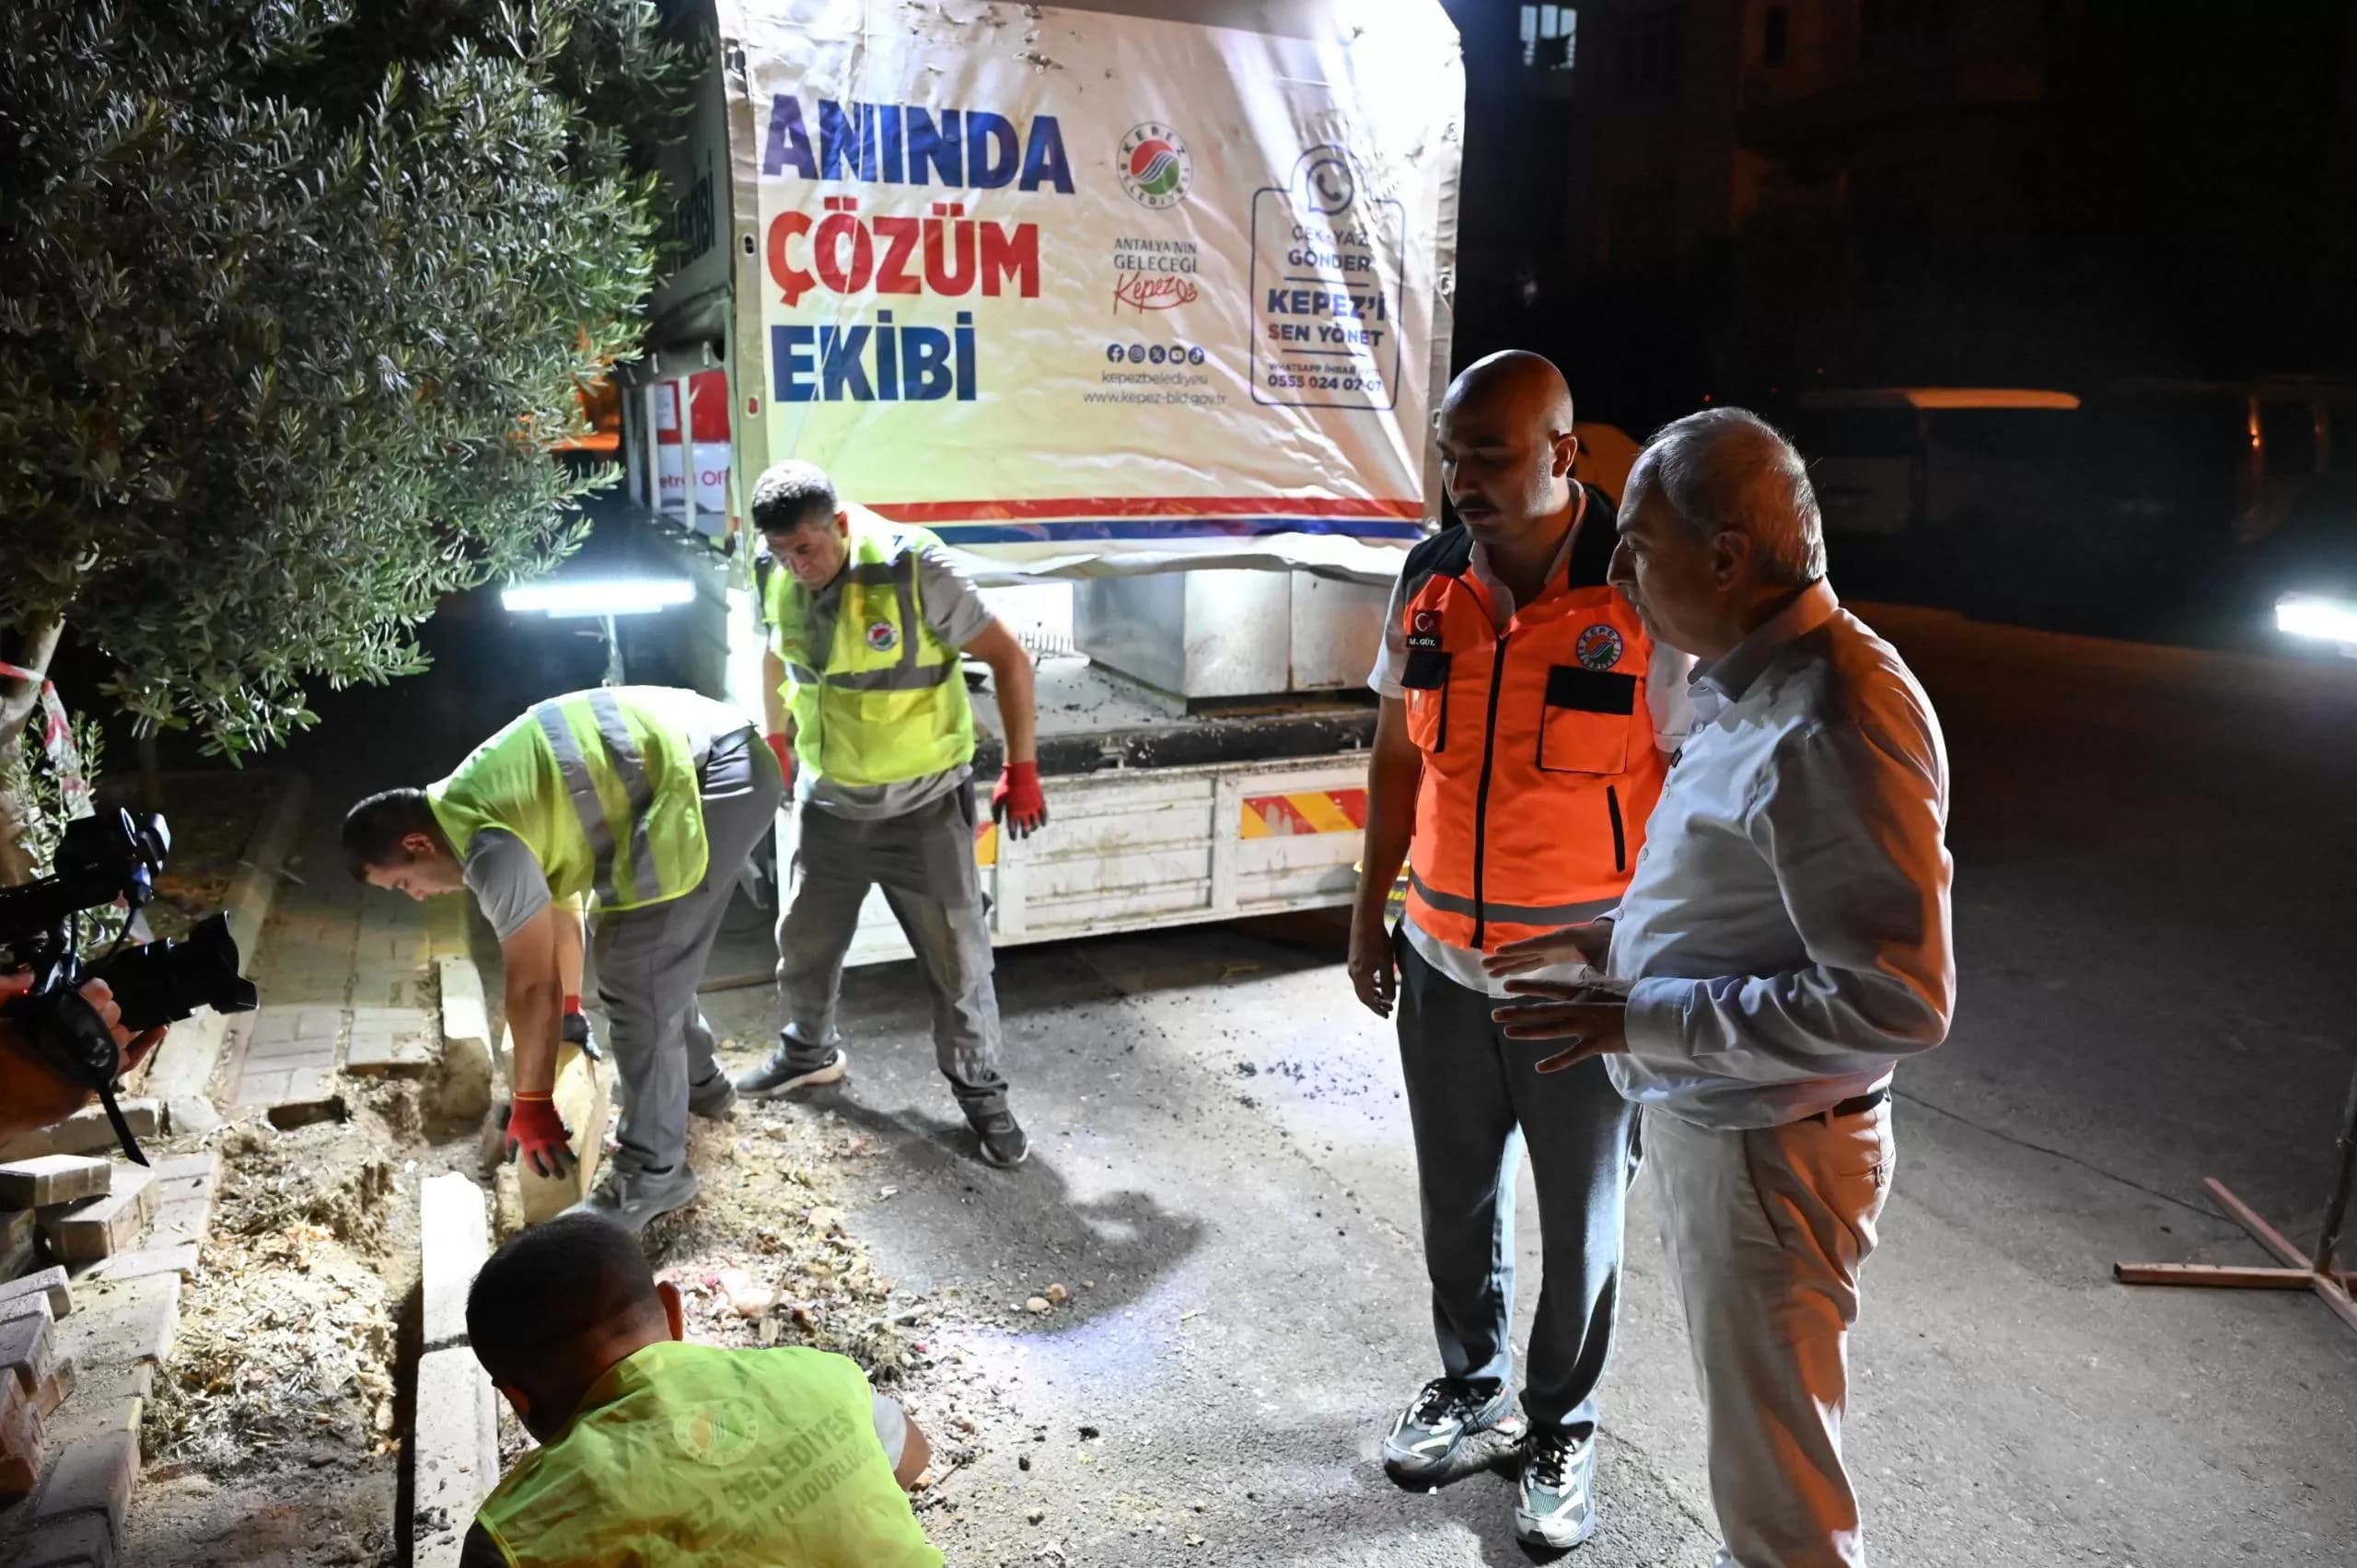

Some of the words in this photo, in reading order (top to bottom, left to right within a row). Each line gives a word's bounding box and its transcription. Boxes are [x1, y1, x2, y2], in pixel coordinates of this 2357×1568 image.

[762, 94, 1075, 194] ANINDA
[767, 196, 1040, 308] ÇÖZÜM
[771, 309, 977, 402] EKİBİ
[1269, 324, 1309, 342] SEN
[1319, 322, 1384, 347] YÖNET
[1309, 376, 1338, 390] 024
